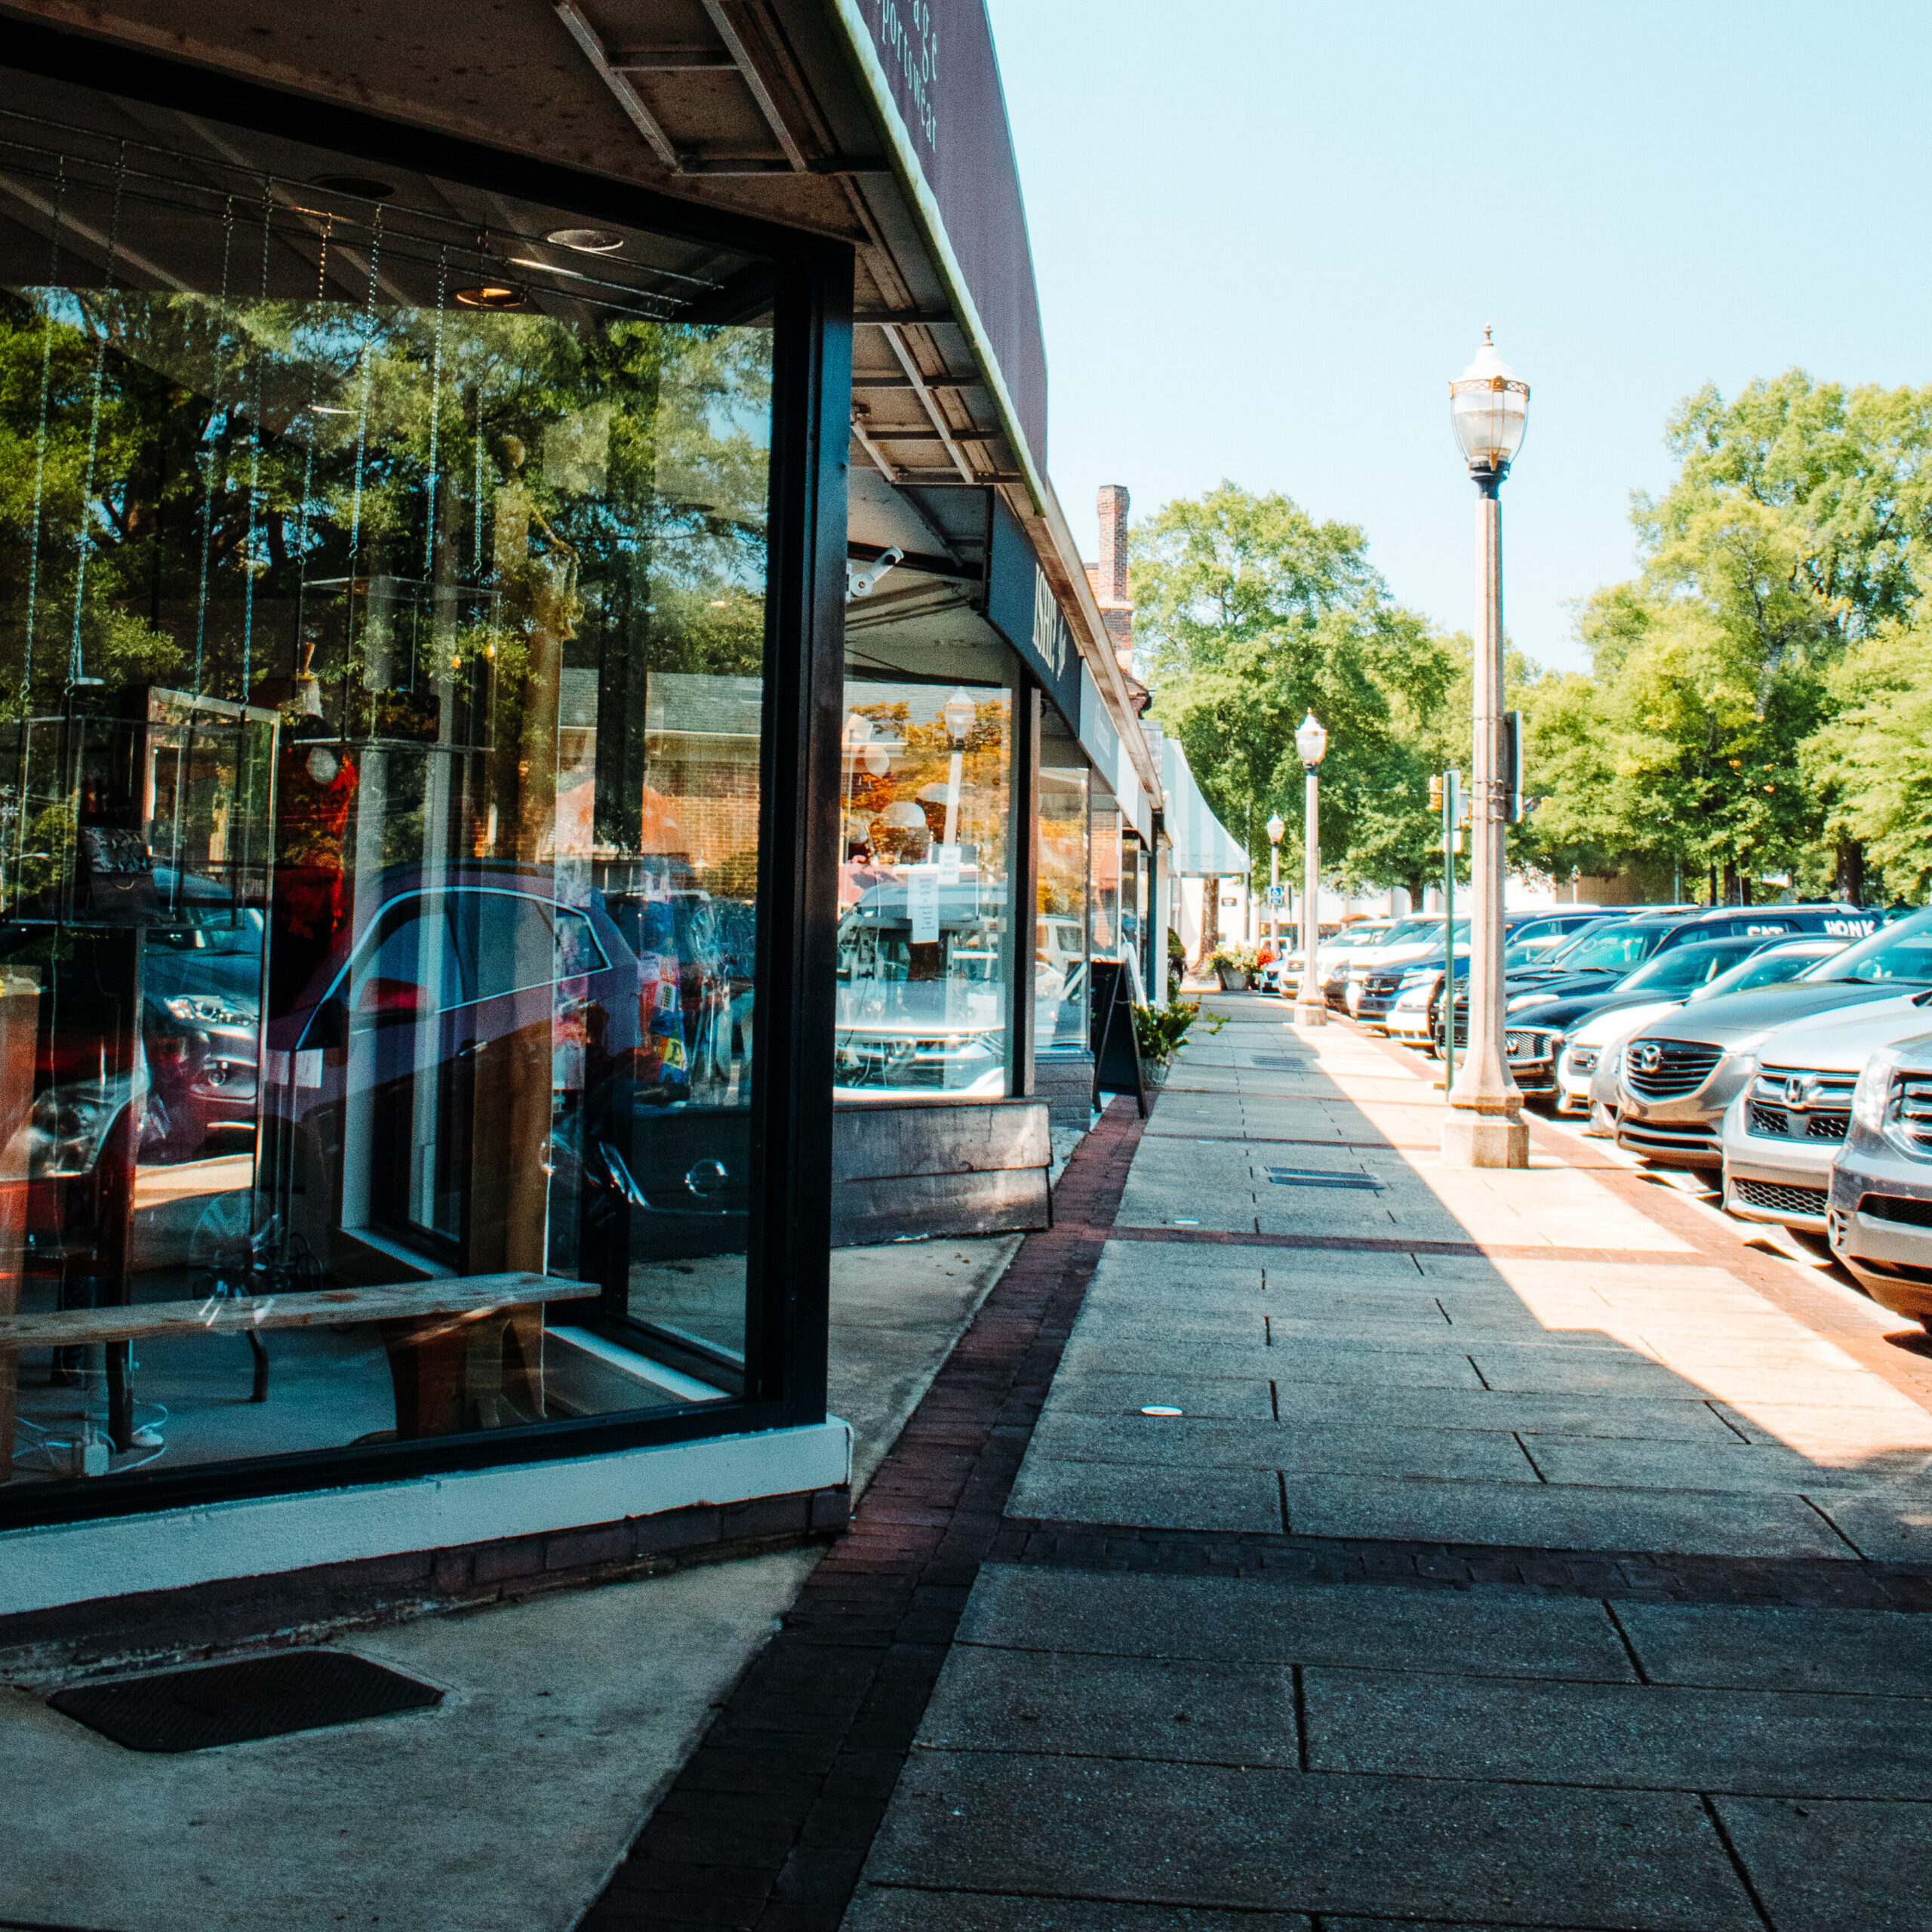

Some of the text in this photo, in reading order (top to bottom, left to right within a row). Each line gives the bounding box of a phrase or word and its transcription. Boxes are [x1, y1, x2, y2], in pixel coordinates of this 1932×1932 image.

[878, 0, 937, 152] portswear
[912, 0, 937, 83] age
[1824, 920, 1875, 938] HONK
